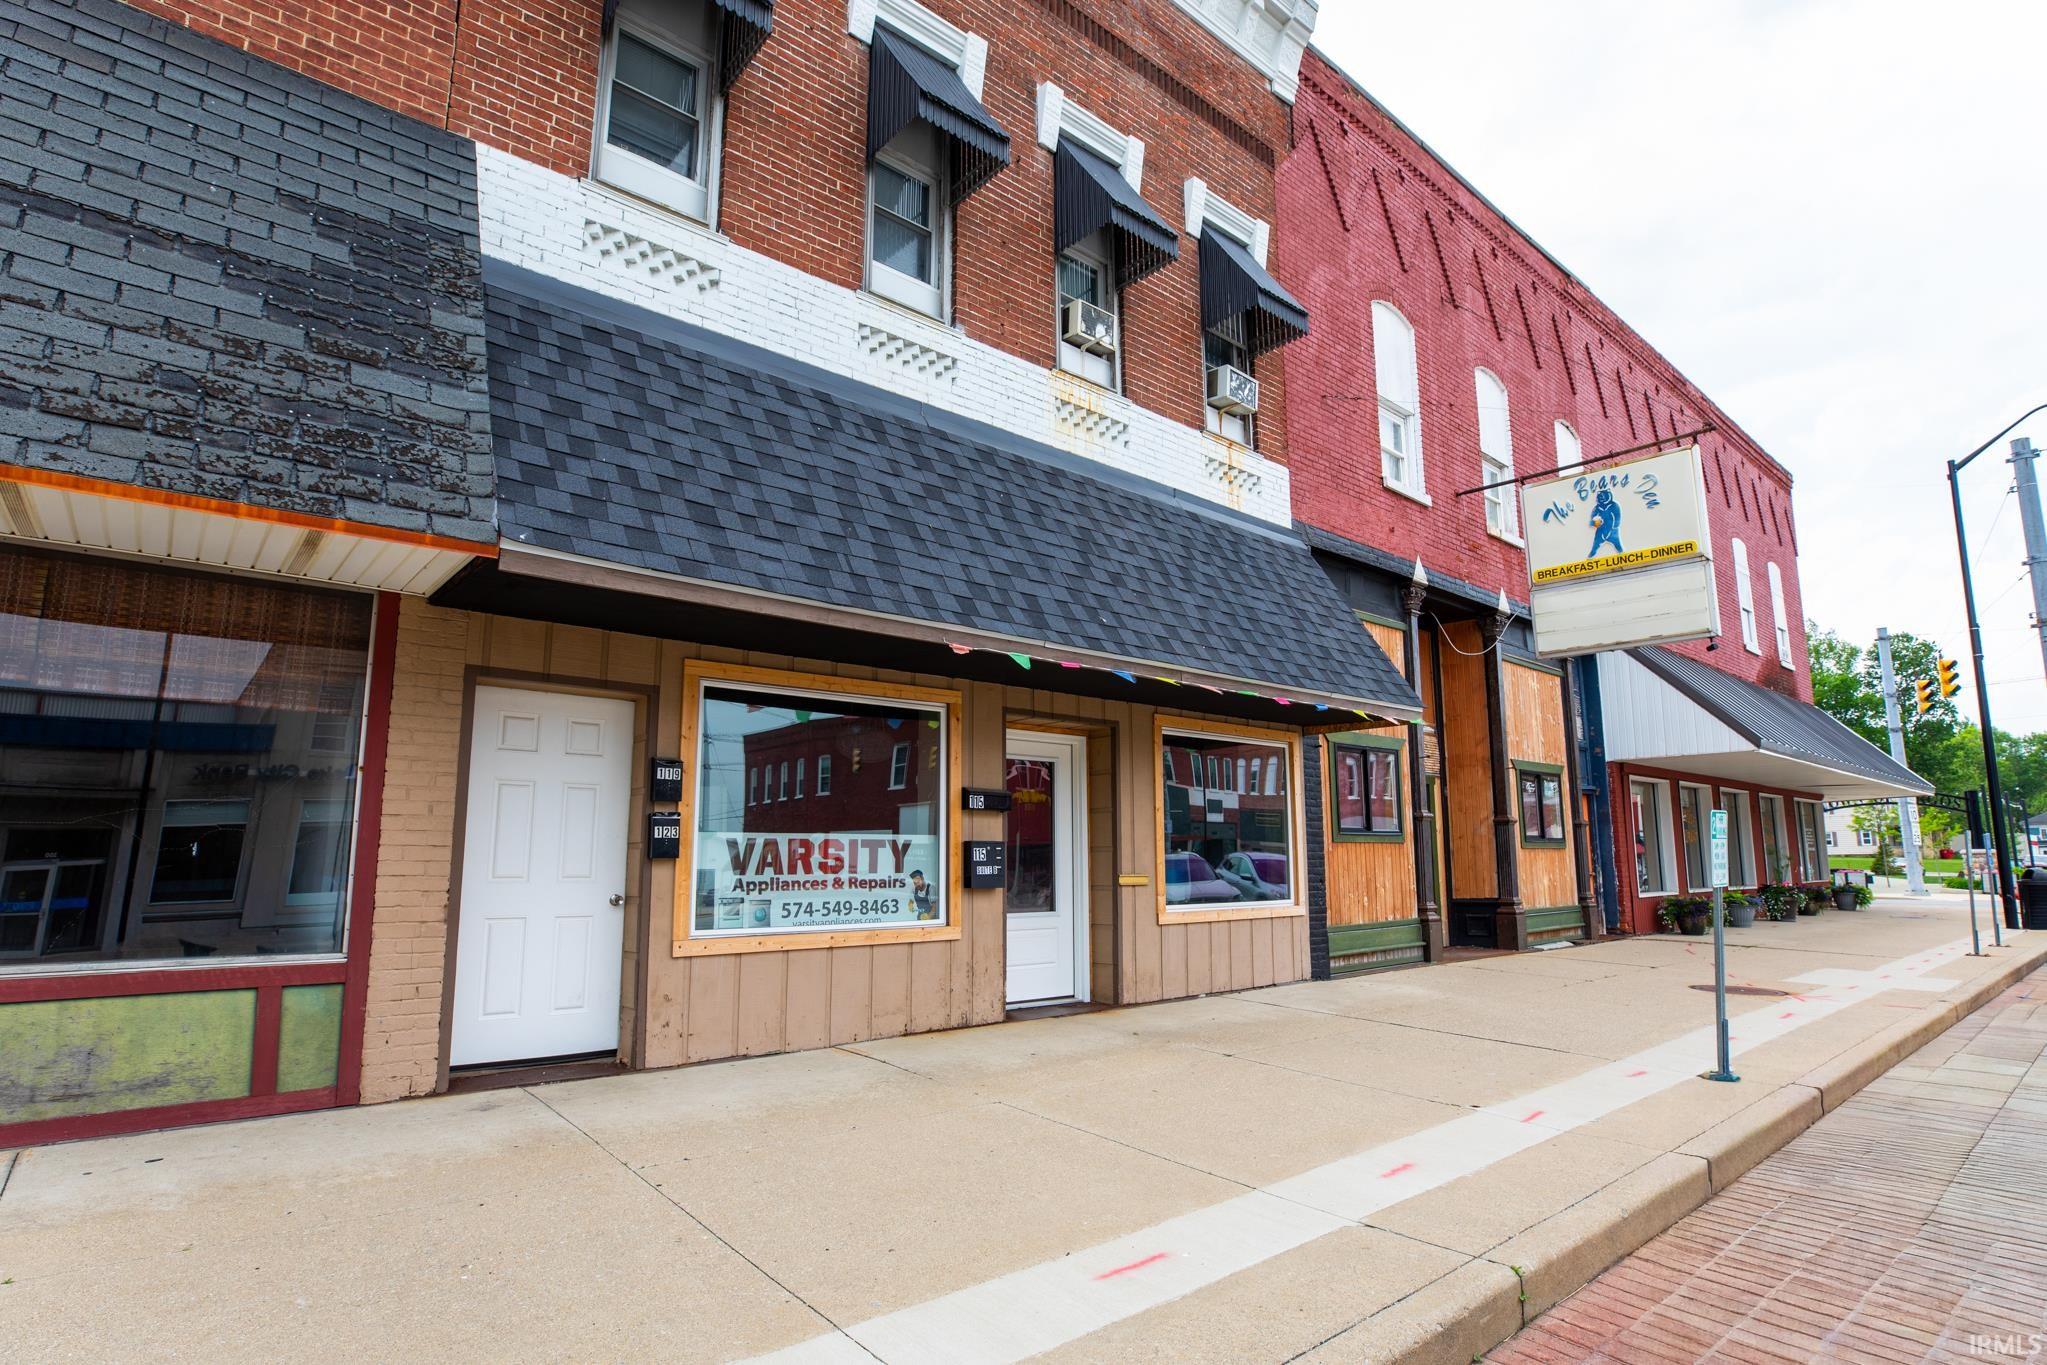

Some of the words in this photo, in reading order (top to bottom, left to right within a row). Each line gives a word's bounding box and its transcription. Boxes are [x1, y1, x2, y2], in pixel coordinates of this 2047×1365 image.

[1543, 500, 1575, 525] The
[1574, 473, 1629, 501] Bears
[1634, 473, 1661, 509] Den
[657, 768, 681, 780] 119
[969, 795, 984, 808] 115
[654, 826, 679, 839] 123
[726, 838, 913, 876] VARSITY
[974, 848, 986, 861] 115
[731, 877, 828, 895] Appliances
[832, 876, 845, 890] &
[848, 875, 906, 892] Repairs
[781, 899, 899, 919] 574-549-8463
